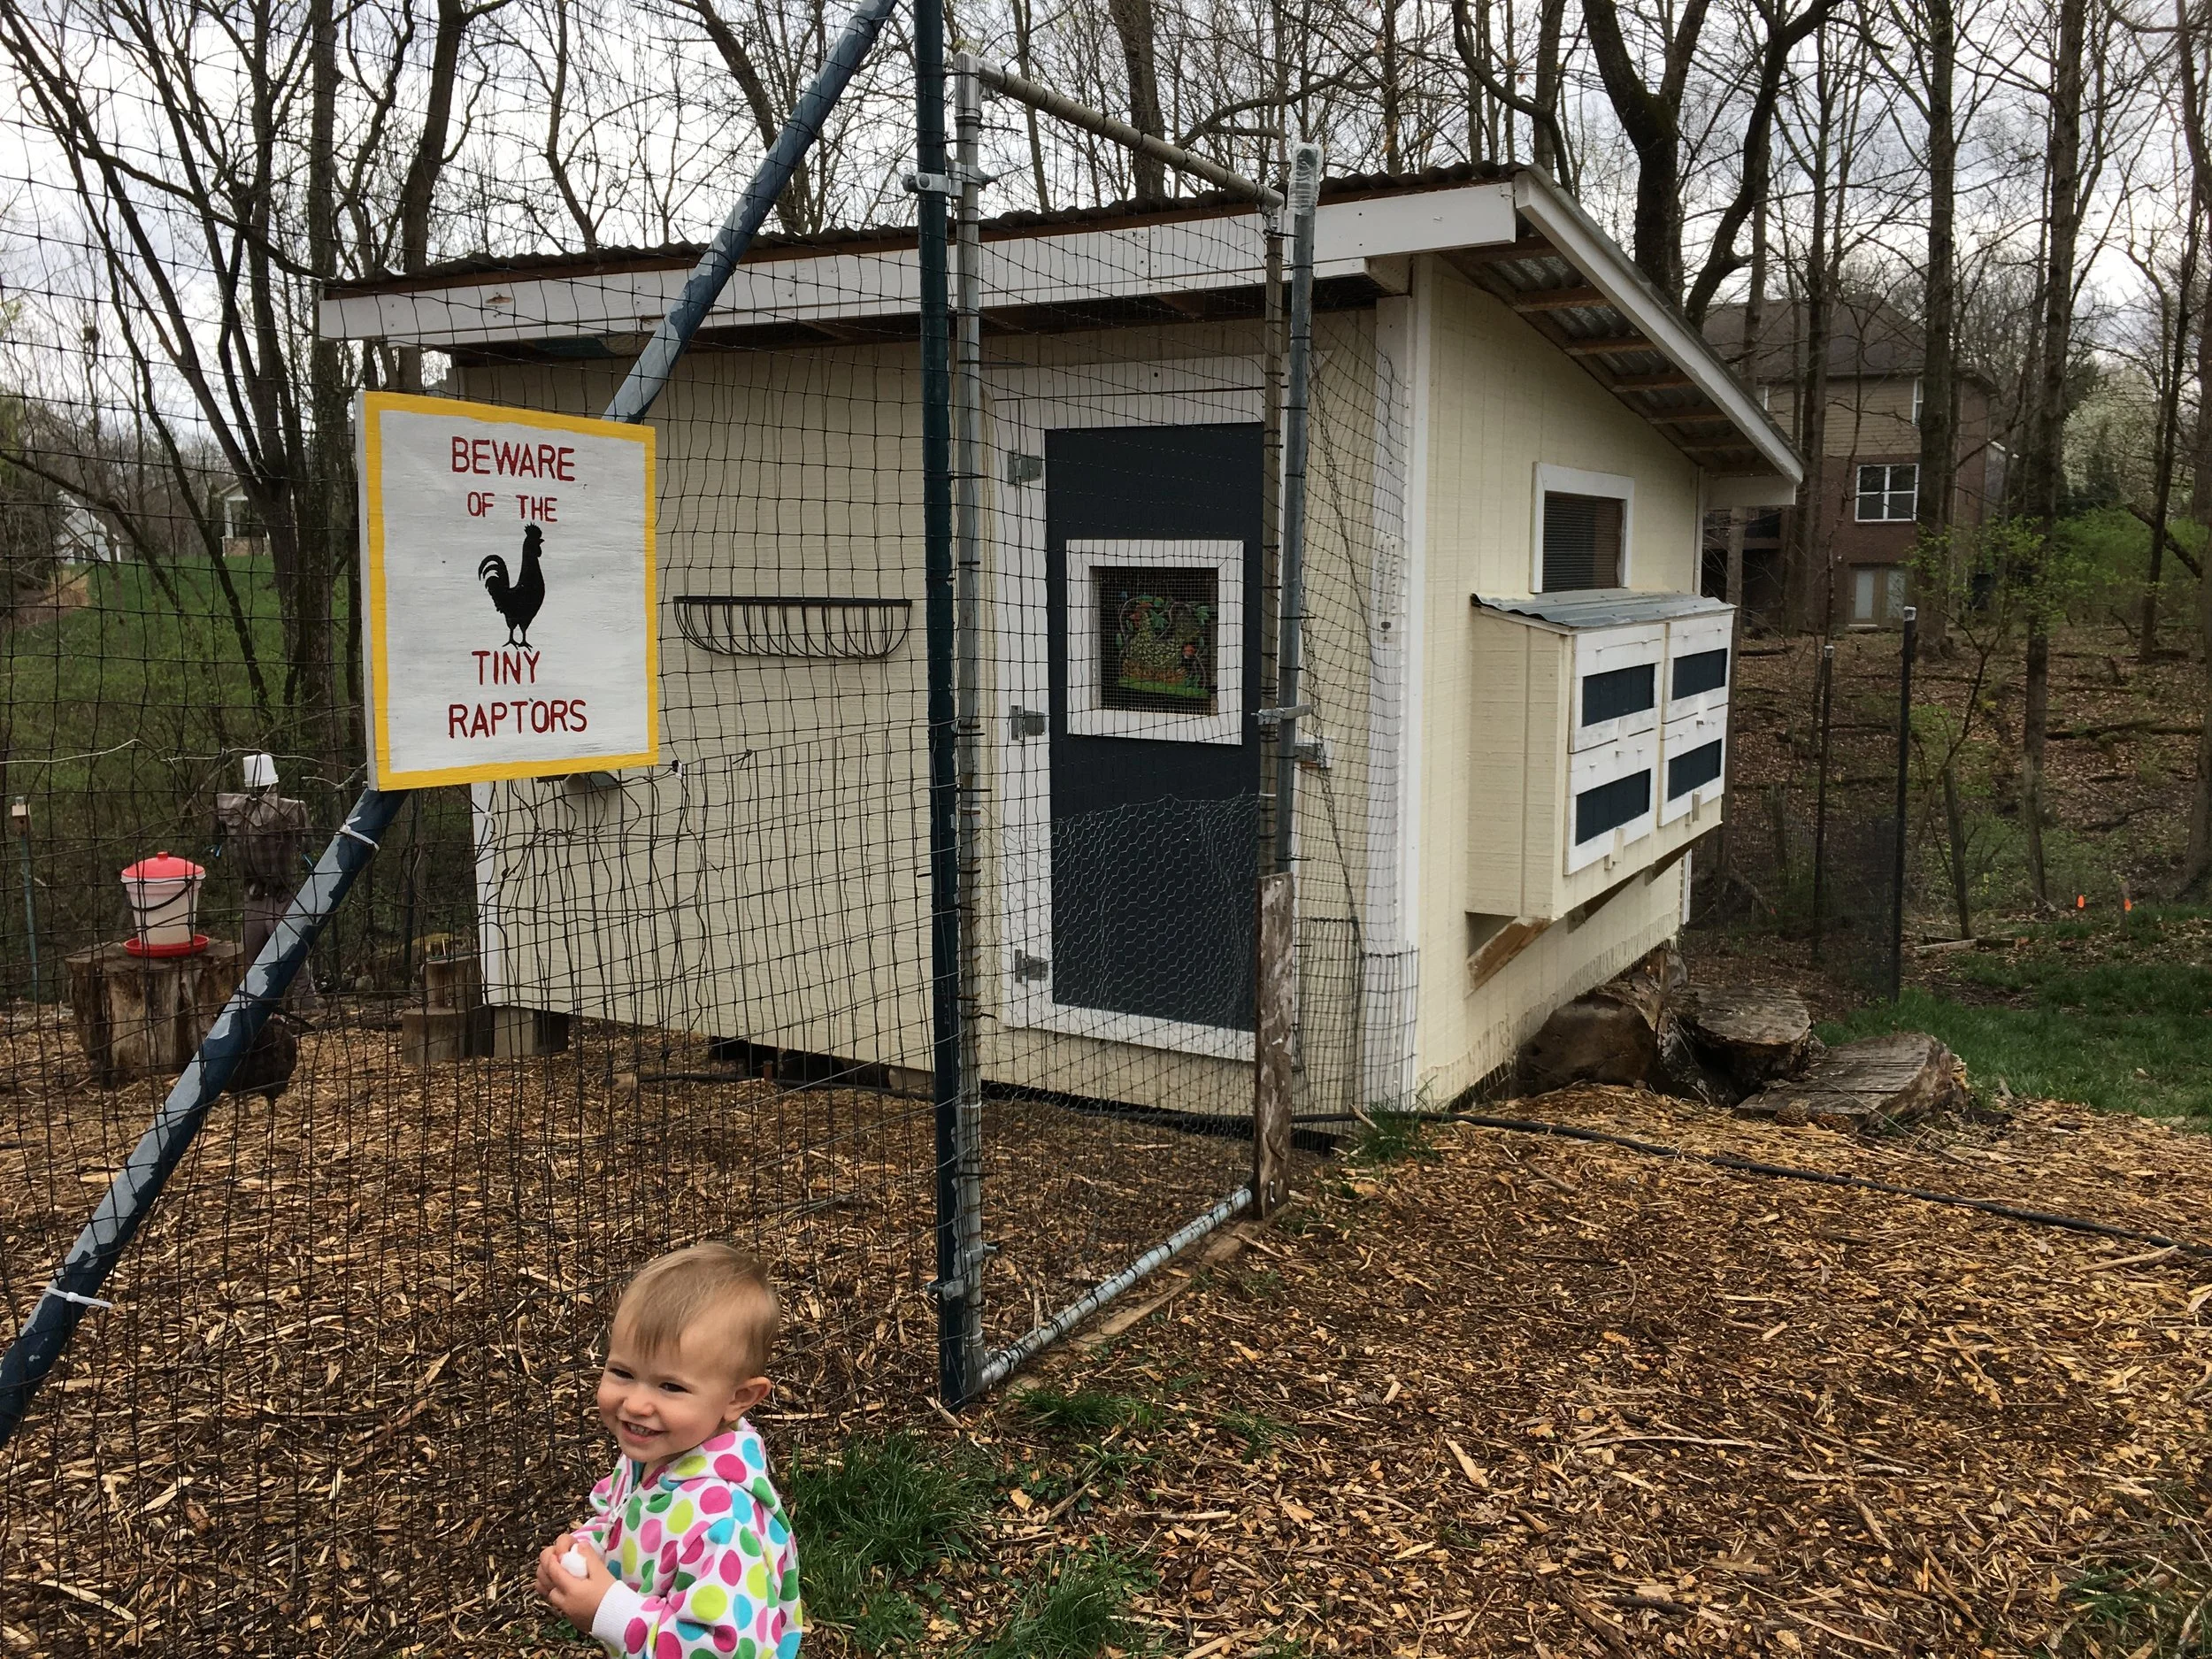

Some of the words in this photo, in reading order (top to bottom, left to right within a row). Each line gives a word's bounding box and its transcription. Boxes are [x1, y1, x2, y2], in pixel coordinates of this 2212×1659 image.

[451, 436, 575, 481] BEWARE
[467, 491, 495, 518] OF
[516, 495, 557, 523] THE
[472, 650, 541, 685] TINY
[449, 699, 588, 738] RAPTORS
